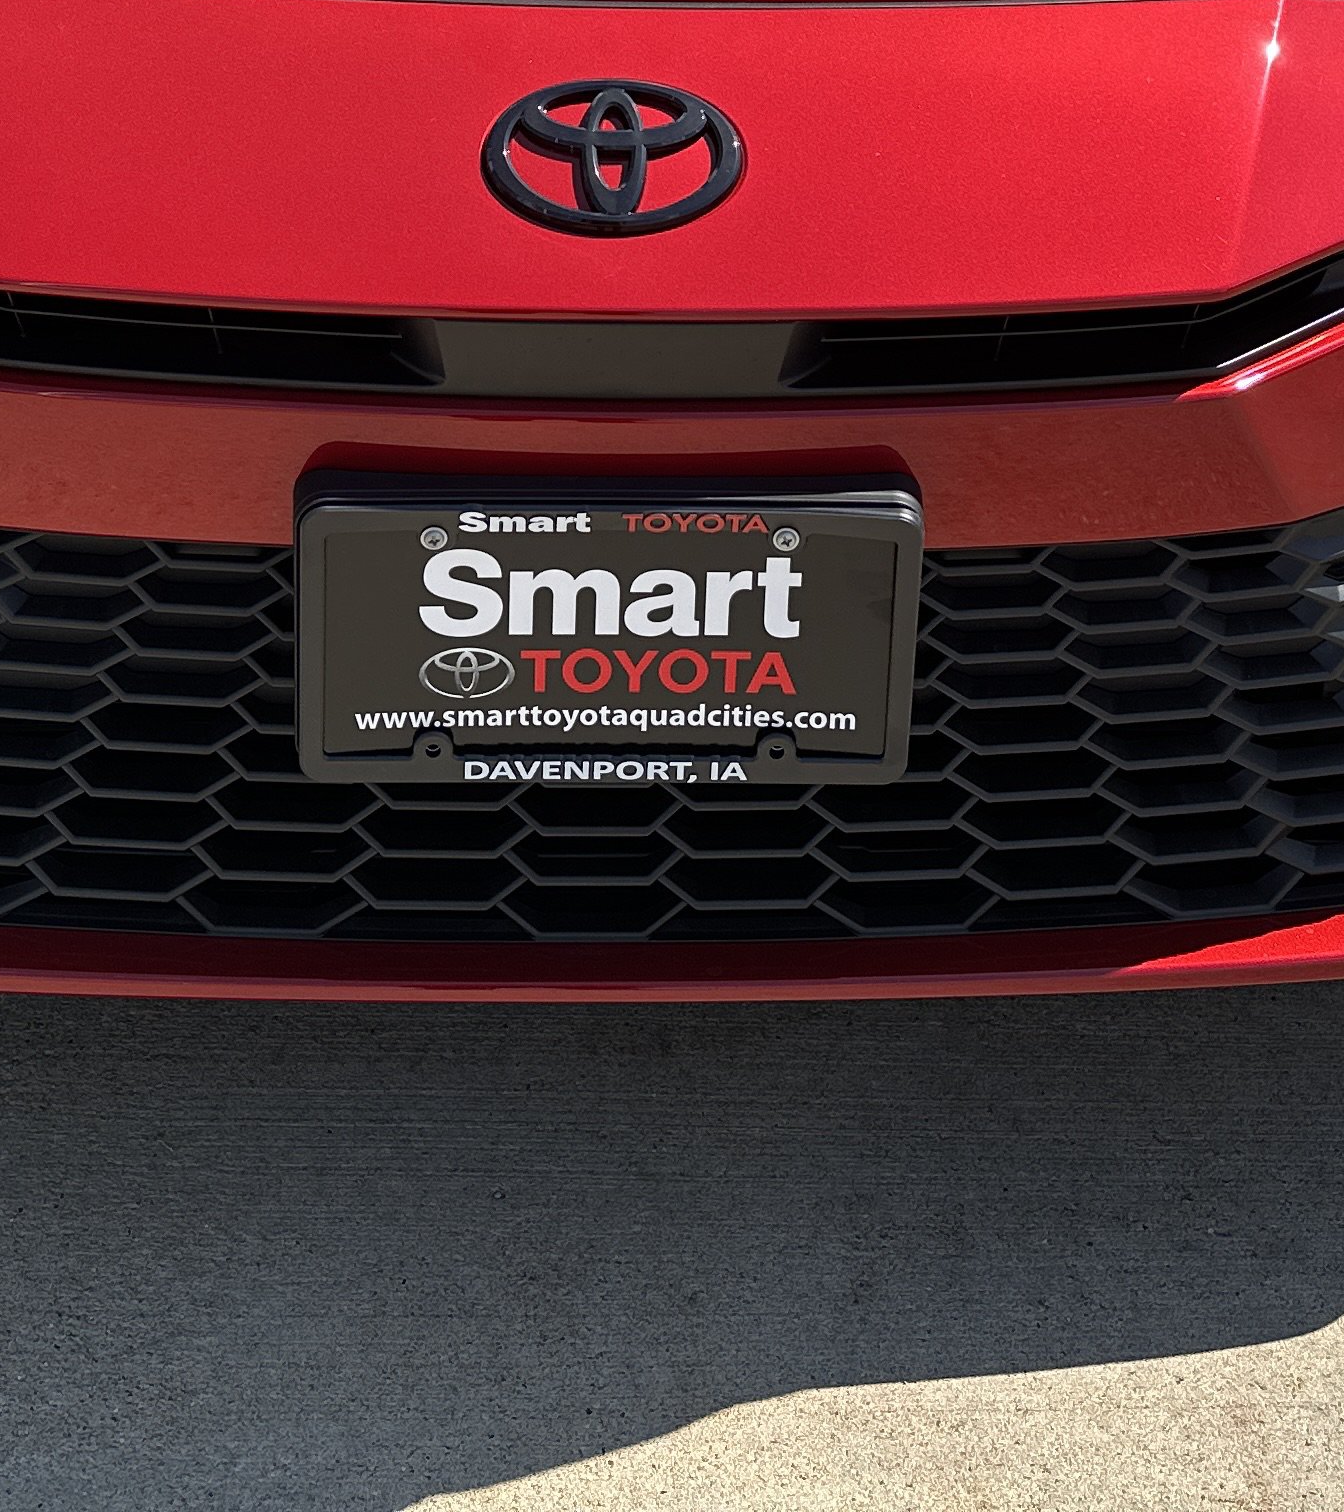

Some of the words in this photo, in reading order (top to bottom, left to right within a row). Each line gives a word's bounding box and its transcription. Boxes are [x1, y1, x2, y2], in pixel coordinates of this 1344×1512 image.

[458, 511, 591, 534] Smart
[622, 513, 771, 535] TOYOTA
[418, 548, 803, 639] Smart
[520, 648, 798, 695] TOYOTA
[354, 703, 857, 732] www.smarttoyotaquadcities.com
[463, 760, 698, 784] DAVENPORT,
[710, 761, 748, 782] IA
